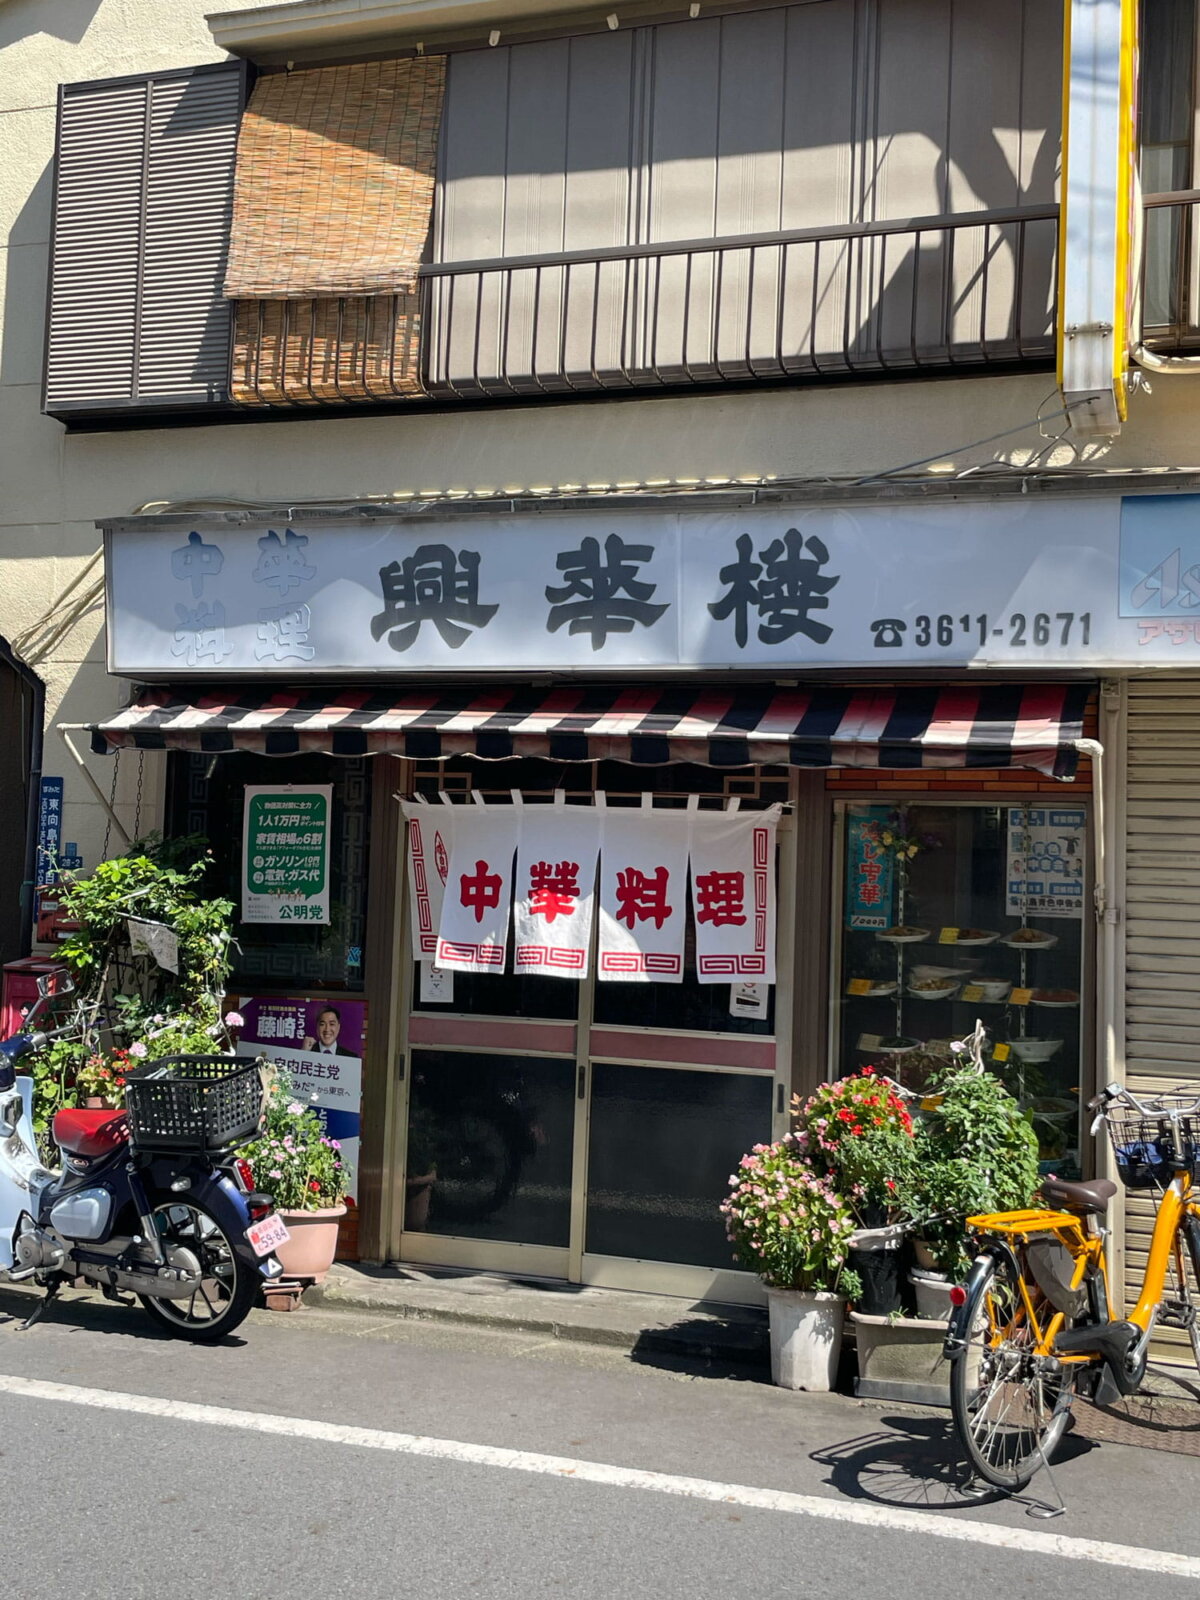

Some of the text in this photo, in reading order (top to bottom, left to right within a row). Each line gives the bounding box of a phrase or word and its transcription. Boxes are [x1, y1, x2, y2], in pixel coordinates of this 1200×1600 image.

[171, 528, 317, 600] 中華
[170, 599, 315, 666] 料理
[1137, 620, 1200, 646] アサ
[258, 815, 300, 826] 1人1万円
[256, 832, 323, 845] 家賃相場の6割
[264, 855, 305, 867] ガソリン
[264, 869, 320, 882] 電気・ガス代
[460, 860, 747, 930] 中華料理
[279, 904, 323, 920] 公明党
[256, 1015, 297, 1039] 藤崎
[296, 1007, 306, 1040] こうき
